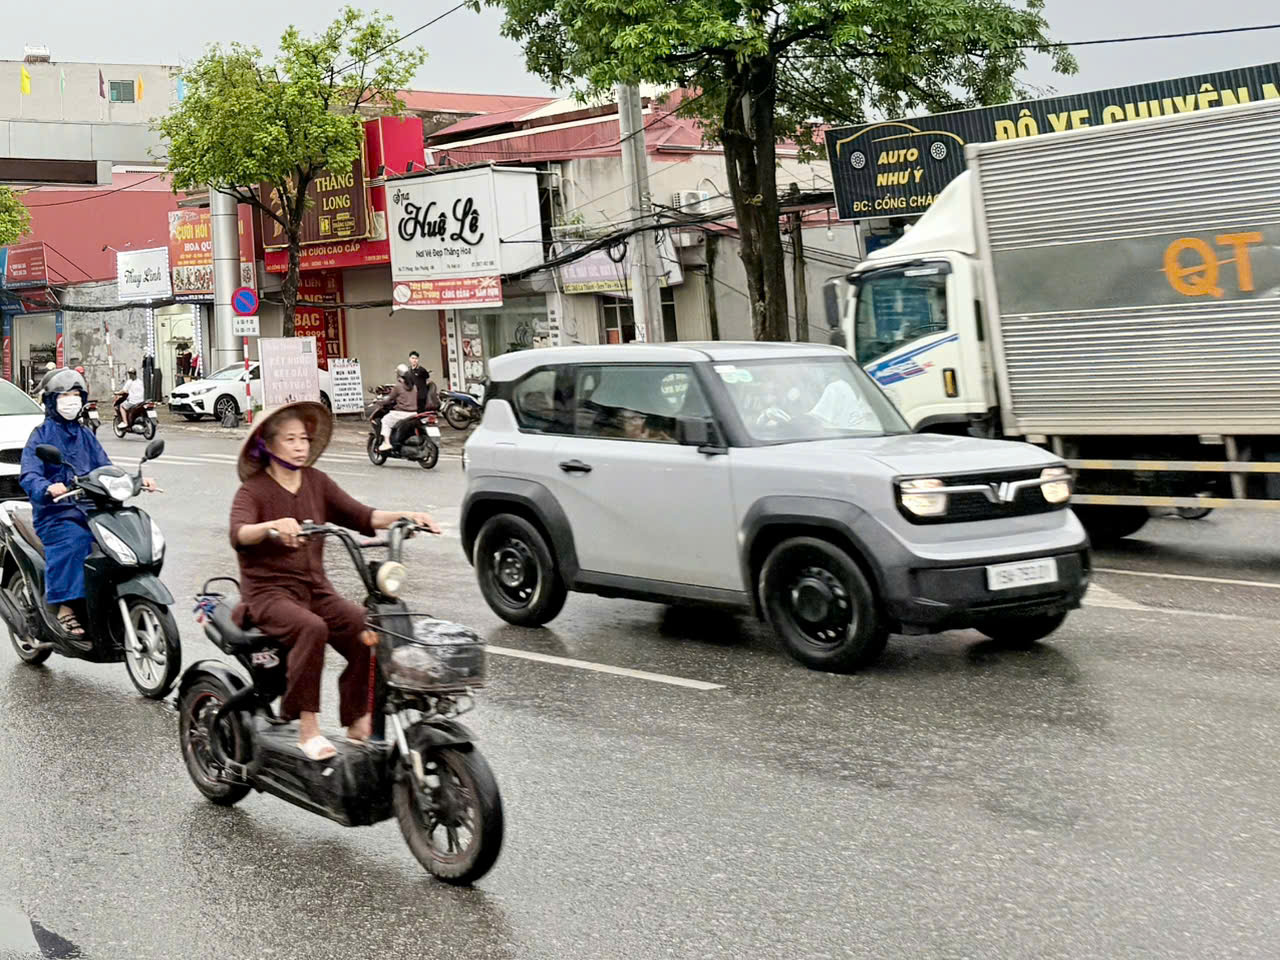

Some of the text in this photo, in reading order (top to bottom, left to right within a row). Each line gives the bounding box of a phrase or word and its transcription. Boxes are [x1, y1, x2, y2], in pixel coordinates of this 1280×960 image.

[877, 147, 919, 165] AUTO
[314, 172, 354, 192] THĂNG
[876, 166, 924, 187] NHƯ Ý
[323, 194, 351, 211] LONG
[853, 201, 872, 211] ĐC:
[875, 193, 907, 210] CỔNG
[398, 197, 484, 246] Huệ Lê
[184, 241, 212, 252] HOA QU
[327, 245, 343, 254] CAO
[1163, 231, 1264, 298] QT
[294, 313, 320, 329] BẠC
